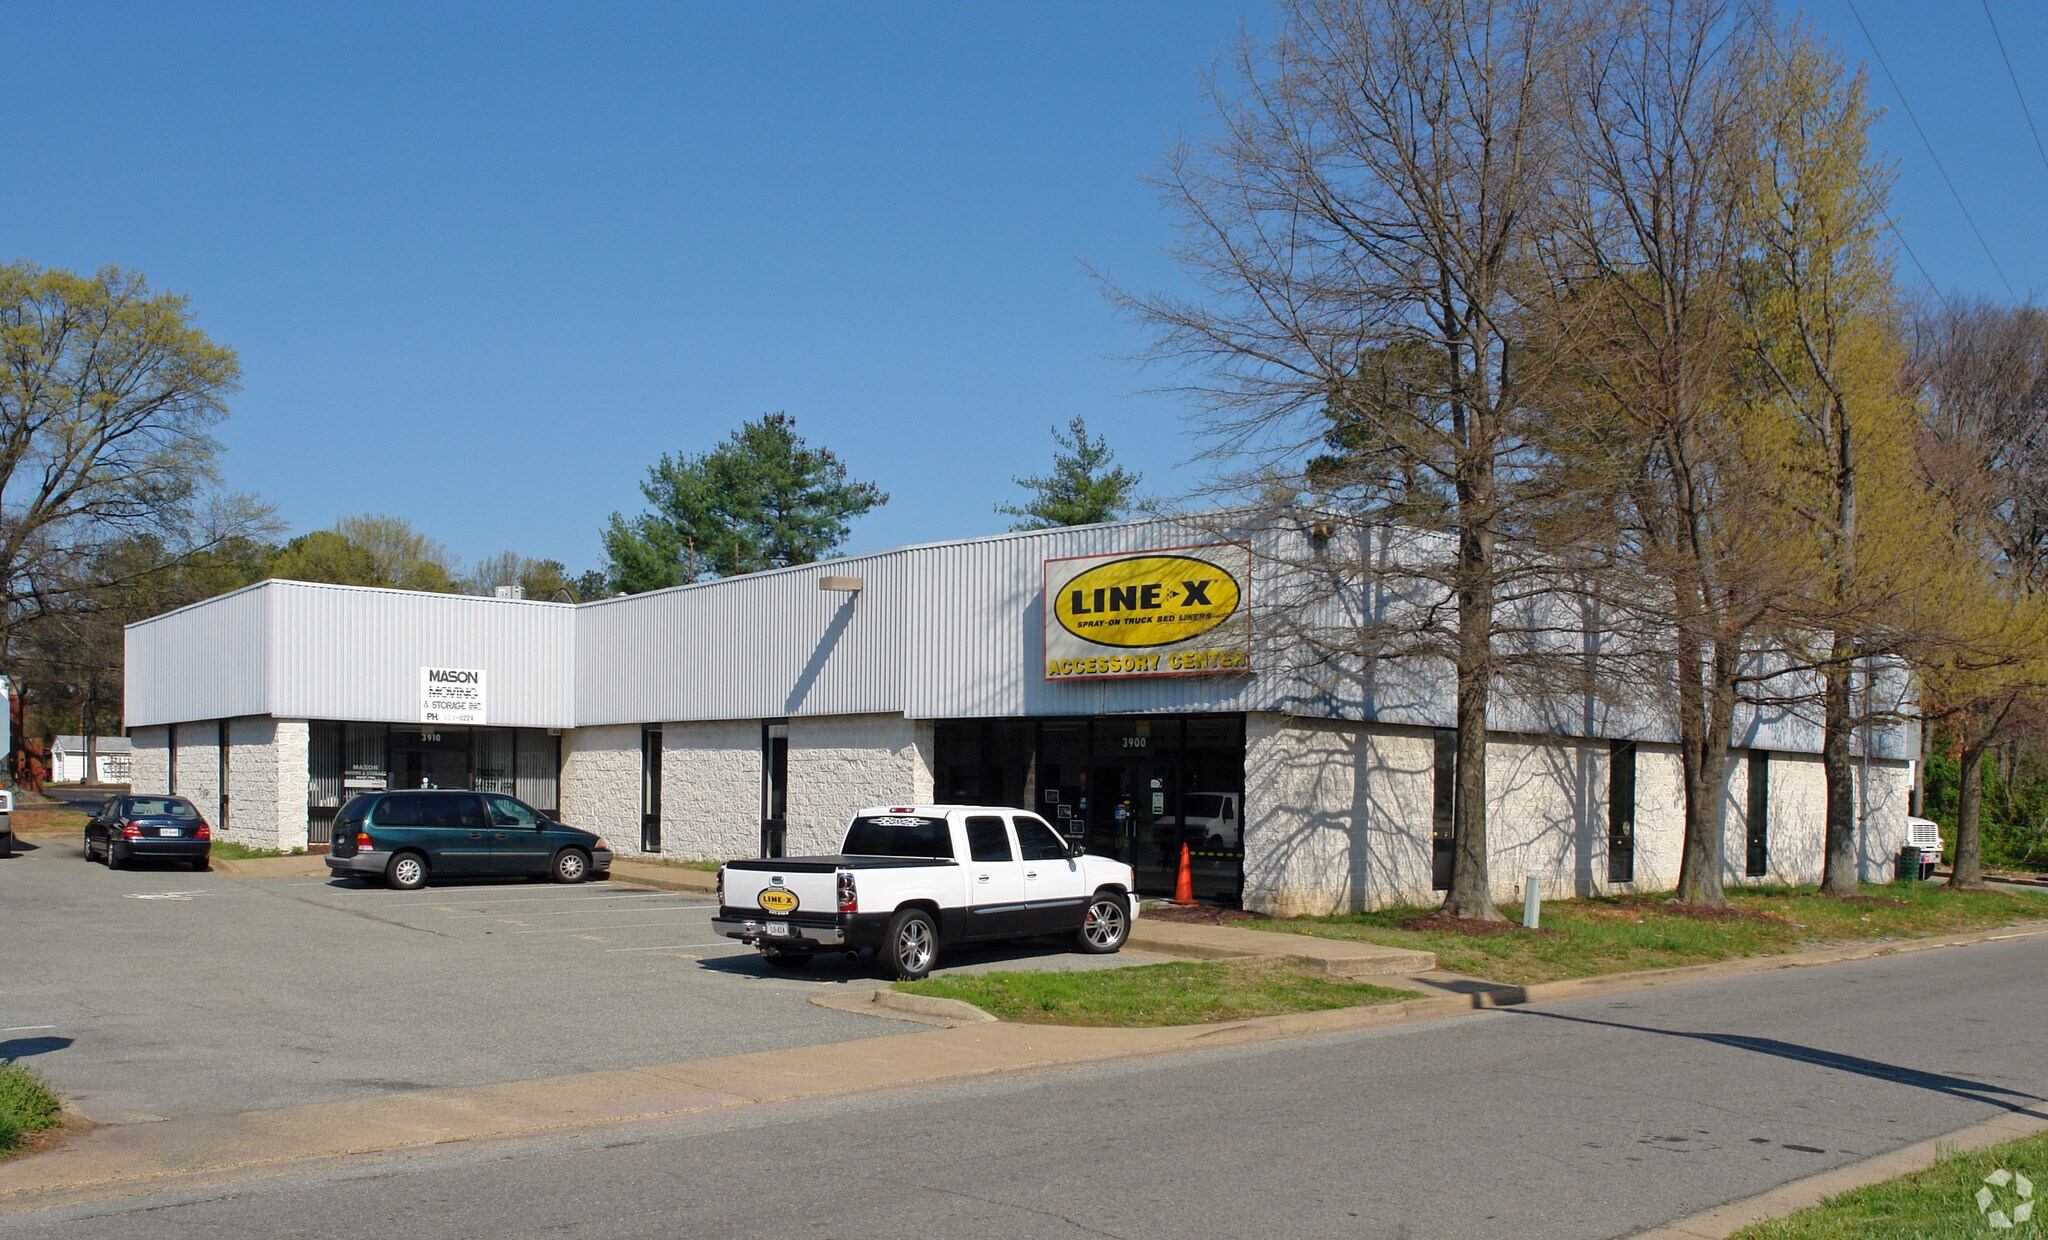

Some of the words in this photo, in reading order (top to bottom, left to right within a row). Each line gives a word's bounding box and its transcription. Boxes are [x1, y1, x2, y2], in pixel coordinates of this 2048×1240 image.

[1077, 618, 1121, 629] SPRAY-ON
[1124, 616, 1153, 625] TRUCK
[1179, 612, 1212, 622] LINERS
[1048, 655, 1161, 676] ACCESSORY
[1168, 649, 1247, 670] CENTER
[429, 669, 478, 684] MASON
[428, 685, 478, 699] MOVING
[431, 701, 467, 710] STORAGE
[421, 733, 441, 742] 3910
[1122, 737, 1146, 748] 3900
